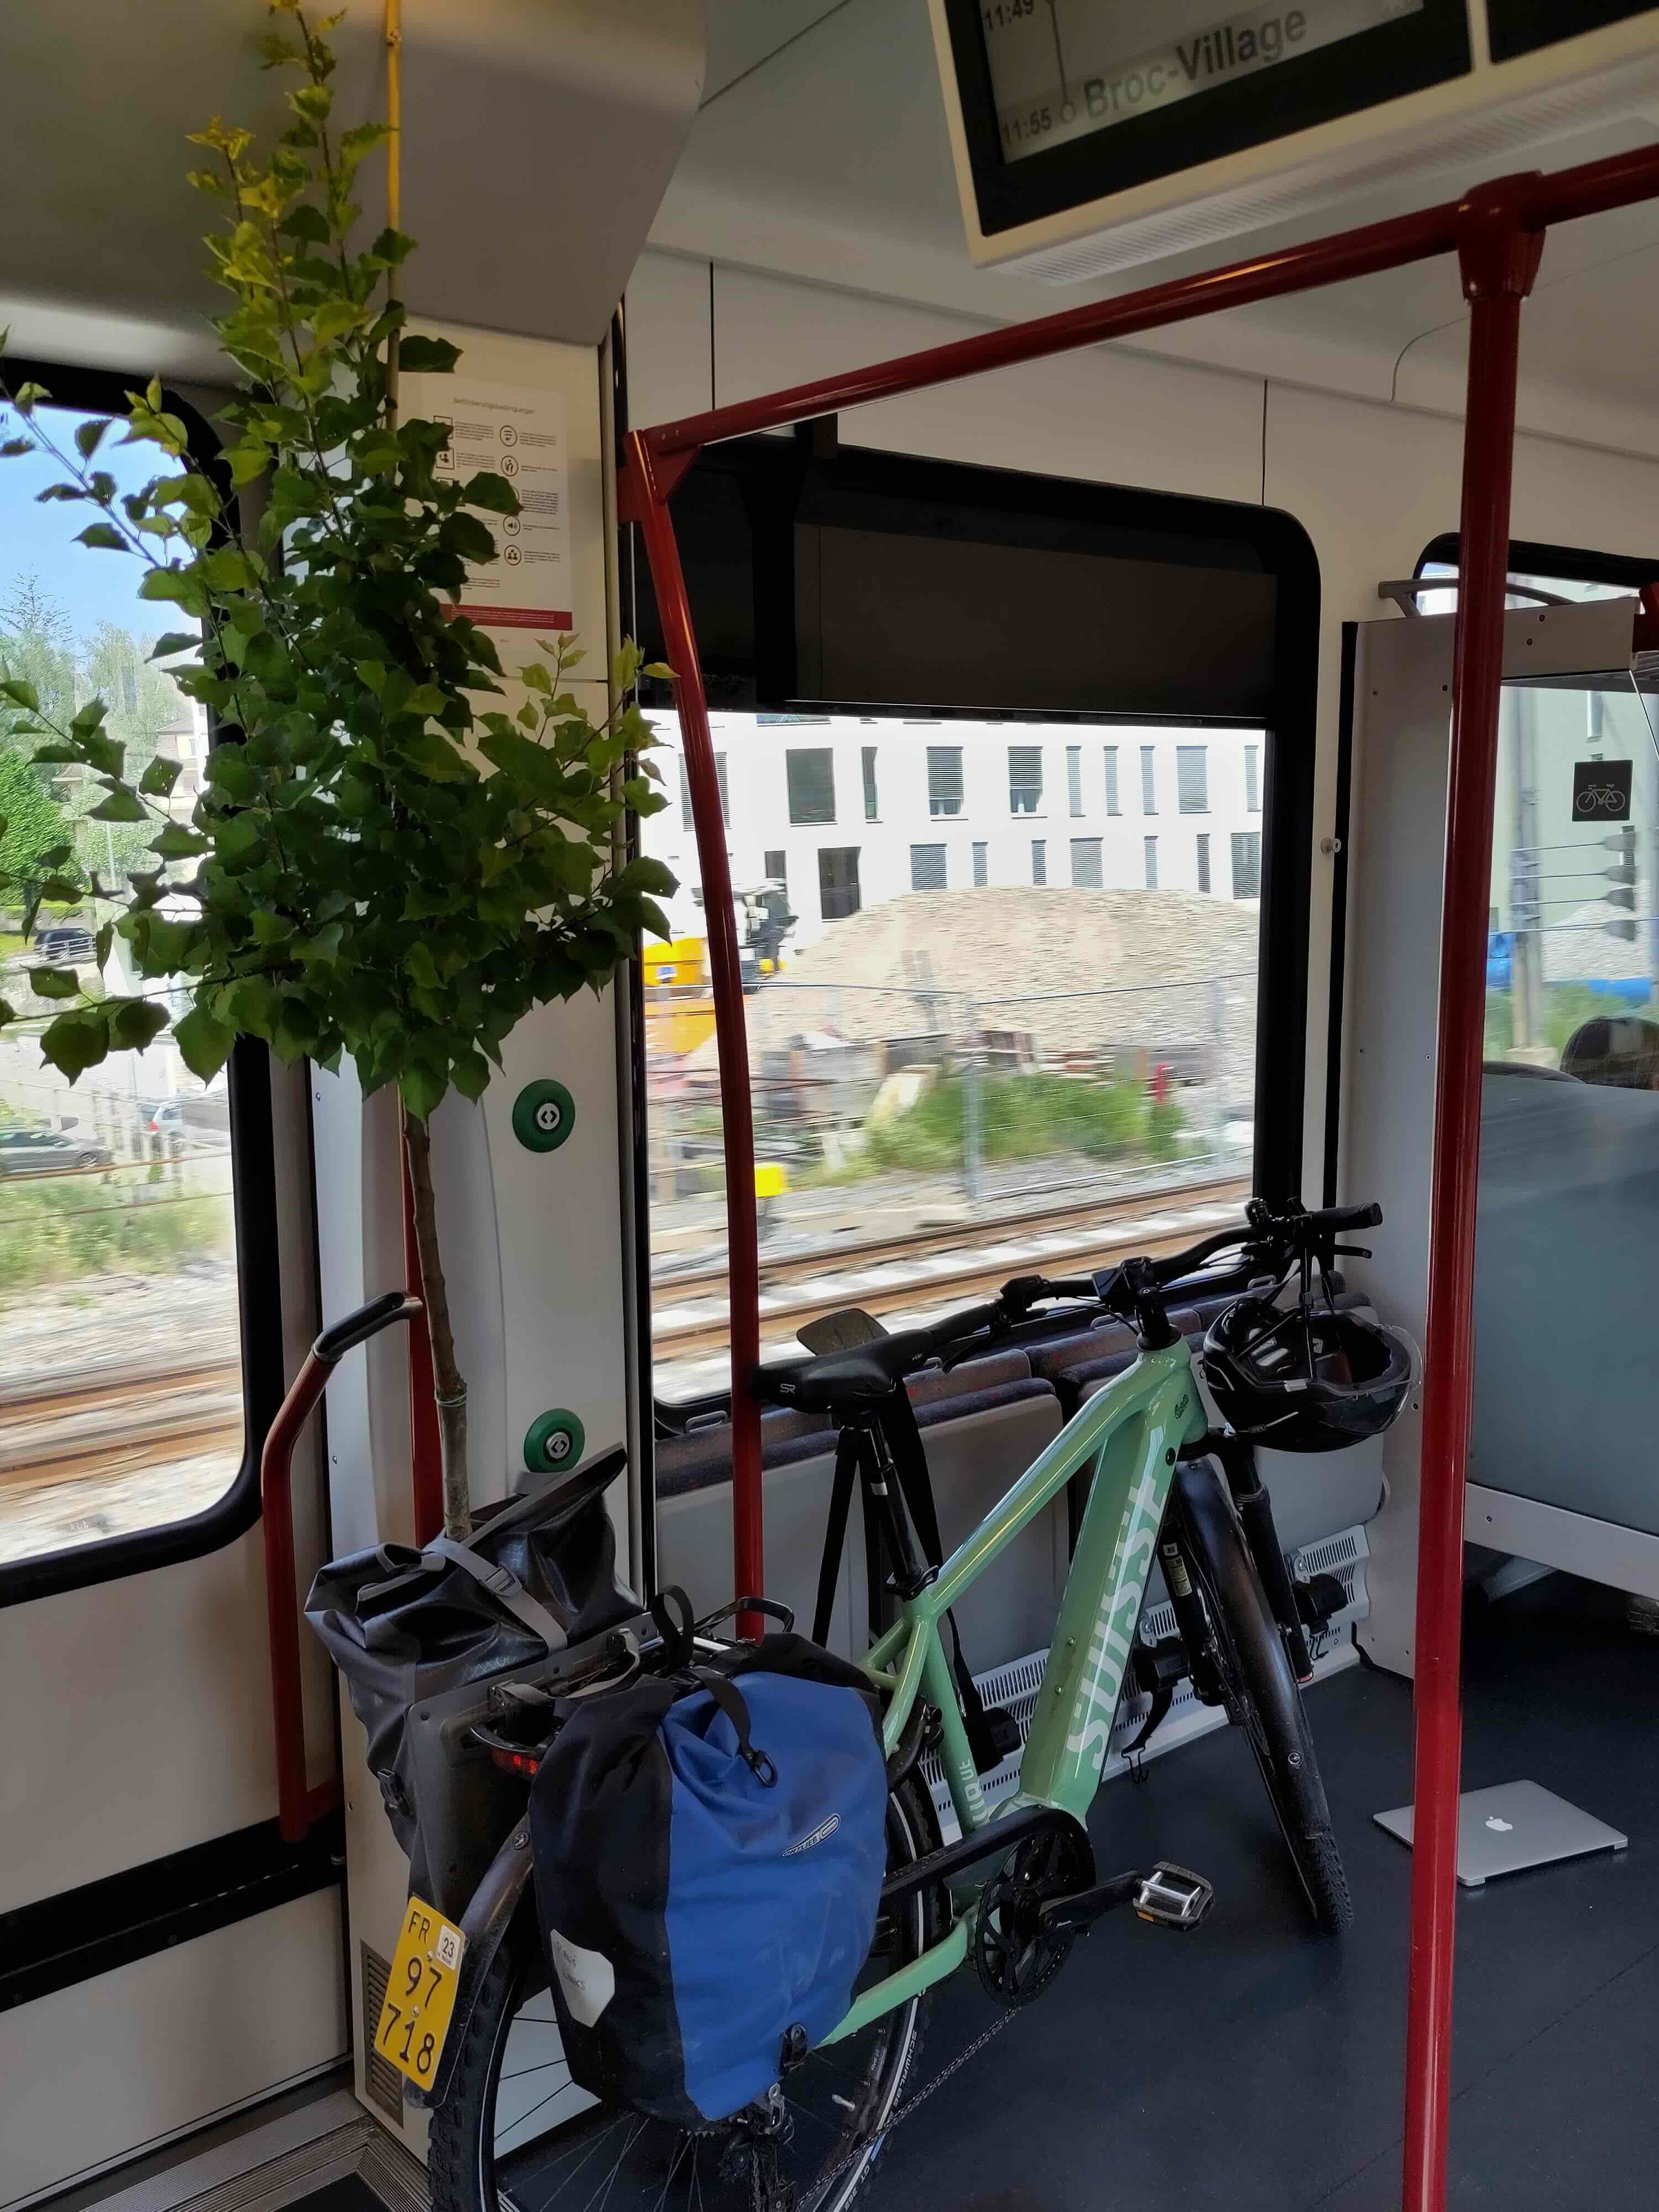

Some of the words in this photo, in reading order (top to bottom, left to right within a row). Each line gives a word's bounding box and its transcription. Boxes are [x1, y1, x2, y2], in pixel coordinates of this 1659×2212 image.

[1001, 107, 1052, 145] 11:55
[1083, 9, 1307, 119] Broc-Village
[1066, 1476, 1167, 1771] SUISSE
[408, 1910, 431, 1945] FR
[442, 1937, 454, 1958] 23
[405, 1956, 443, 2009] 97
[383, 2002, 435, 2074] 718
